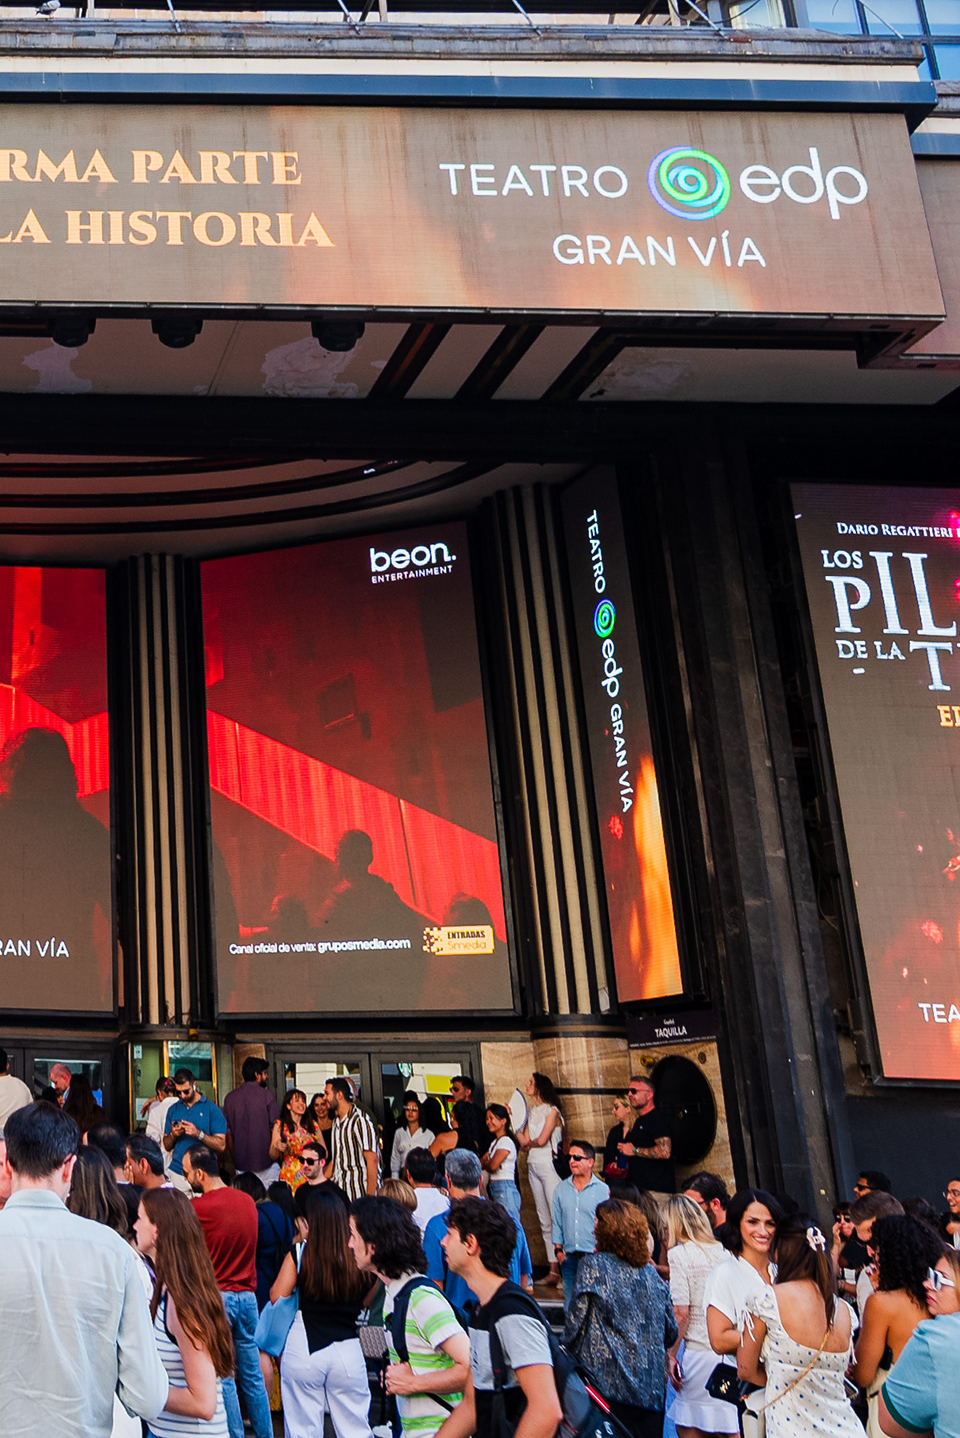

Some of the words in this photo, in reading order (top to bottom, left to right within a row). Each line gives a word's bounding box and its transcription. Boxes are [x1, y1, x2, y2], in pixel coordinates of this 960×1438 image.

[131, 150, 303, 185] PARTE
[439, 164, 628, 198] TEATRO
[739, 146, 868, 220] edp
[65, 210, 336, 247] HISTORIA
[552, 233, 676, 267] GRAN
[687, 230, 766, 267] VÍA
[837, 522, 878, 535] DARIO
[881, 524, 953, 538] REGATTIERI
[586, 509, 606, 594] TEATRO
[821, 549, 863, 569] LOS
[371, 565, 453, 584] ENTERTAINMENT
[825, 551, 960, 637] PIL
[835, 639, 869, 659] DE
[874, 641, 906, 660] LA
[601, 638, 623, 698] edp
[610, 703, 628, 768] GRAN
[35, 937, 69, 957] VÍA
[229, 943, 253, 954] Canal
[254, 943, 277, 953] oficial
[278, 942, 290, 953] de
[317, 938, 411, 953] gruposmedia.com
[447, 930, 485, 940] ENTRADAS
[654, 1026, 688, 1038] TAQUILLA
